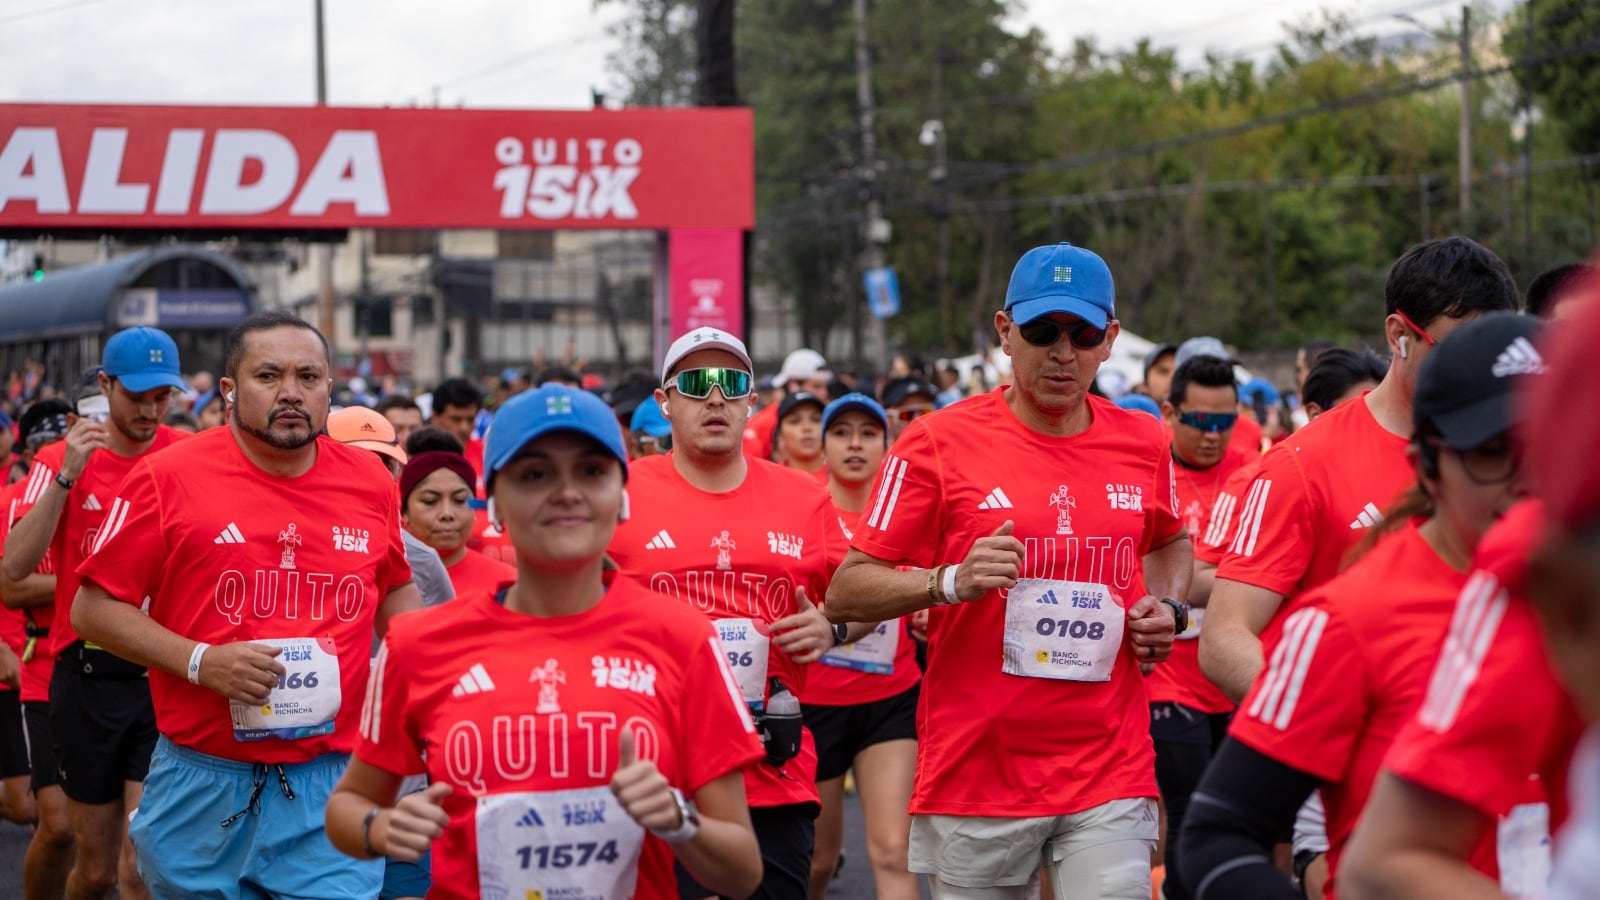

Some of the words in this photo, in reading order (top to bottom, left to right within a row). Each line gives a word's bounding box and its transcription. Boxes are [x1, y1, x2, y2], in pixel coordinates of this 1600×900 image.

[495, 136, 643, 165] QUITO
[0, 126, 391, 216] ALIDA
[1106, 483, 1142, 496] QUITO
[332, 526, 369, 538] QUITO
[768, 531, 804, 545] QUITO
[1000, 536, 1134, 599] UITO
[215, 569, 365, 625] QUITO
[1072, 590, 1103, 598] QUITO
[1036, 617, 1105, 640] 0108
[1052, 651, 1079, 659] BANCO
[1051, 658, 1092, 667] PICHINCHA
[275, 707, 313, 715] PICHINCHA
[516, 839, 620, 870] 11574
